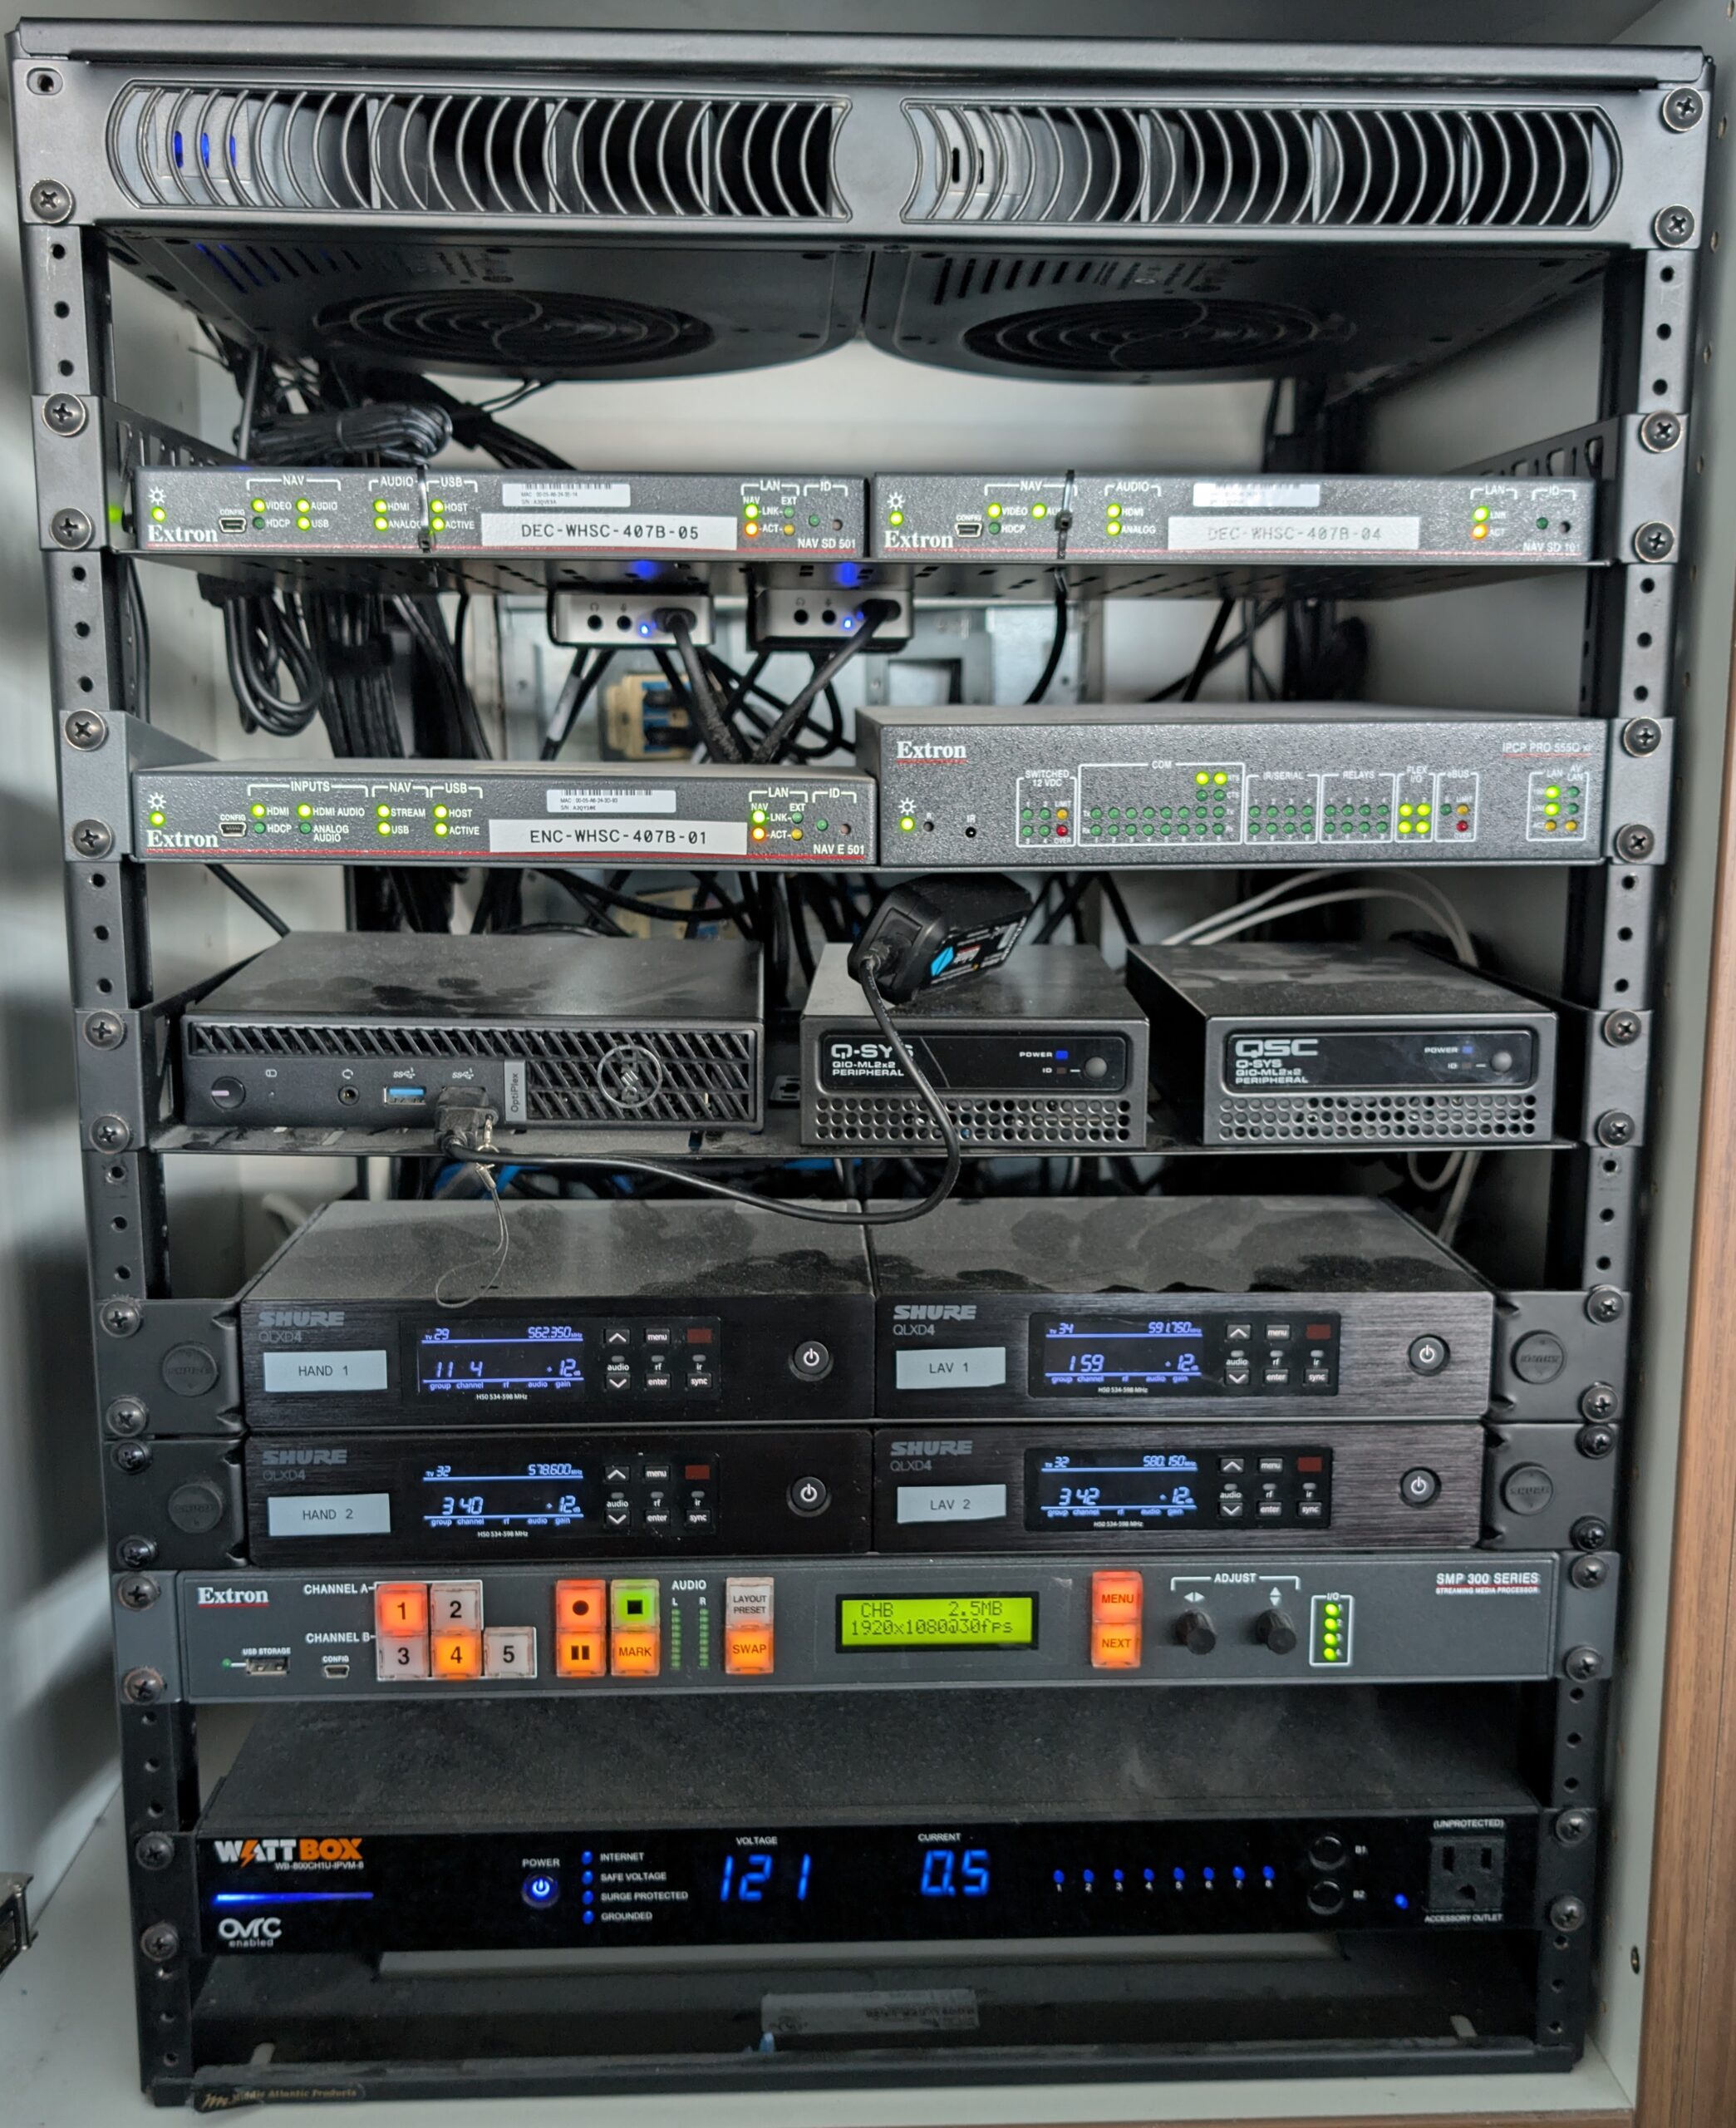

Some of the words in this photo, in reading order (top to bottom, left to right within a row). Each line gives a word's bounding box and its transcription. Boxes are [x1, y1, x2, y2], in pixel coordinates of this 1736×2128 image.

[283, 476, 304, 486] NAV
[380, 477, 414, 488] AUDIO
[440, 477, 463, 488] USB
[760, 480, 780, 490] LAN
[820, 481, 832, 491] ID
[1019, 482, 1042, 491] NAV
[1116, 482, 1149, 492] AUDIO
[1486, 485, 1505, 495] LAN
[267, 501, 292, 511] VIDEO
[782, 497, 798, 505] EXT
[312, 502, 337, 512] AUDIO
[387, 502, 410, 512] HDMI
[444, 503, 468, 513] HOST
[267, 519, 290, 530] HDCP
[312, 520, 328, 530] USB
[445, 520, 476, 530] ACTIVE
[149, 525, 219, 544] Extron
[521, 525, 699, 539] DEC-WHSC-407B-05
[799, 539, 818, 549] NAV
[821, 539, 835, 549] SD
[839, 539, 855, 549] 501
[885, 530, 953, 549] Extron
[1547, 543, 1561, 553] SD
[897, 741, 967, 758] Extron
[1502, 742, 1527, 753] IPCP
[1530, 742, 1552, 753] PRO
[1152, 761, 1173, 770] COM
[1407, 766, 1427, 774] FLEX
[1025, 770, 1070, 778] SWITCHED
[1263, 771, 1304, 780] IR/SERIAL
[1343, 771, 1375, 779] RELAYS
[1447, 769, 1469, 778] eBUS
[291, 781, 330, 791] INPUTS
[390, 782, 411, 793] NAV
[445, 783, 467, 794] USB
[1044, 779, 1062, 787] VDC
[769, 787, 789, 798] LAN
[829, 788, 840, 798] ID
[267, 808, 289, 818] HDMI
[789, 803, 806, 812] EXT
[219, 814, 246, 822] CONFIG
[337, 809, 365, 820] AUDIO
[391, 809, 425, 819] STREAM
[449, 810, 473, 820] HOST
[267, 825, 292, 836] HDCP
[313, 825, 349, 835] ANALOG
[391, 826, 409, 835] USB
[450, 826, 479, 836] ACTIVE
[147, 830, 219, 848] Extron
[530, 830, 706, 845] ENC-WHSC-407B-01
[814, 845, 834, 855] NAV
[838, 845, 845, 855] E
[848, 845, 864, 855] 501
[1236, 1039, 1318, 1057] QSC
[1236, 1059, 1282, 1069] Q-SYS
[511, 1072, 522, 1113] OptiPlex
[893, 1305, 976, 1322] SHURE
[259, 1311, 345, 1328] SHURE
[435, 1328, 450, 1340] 29
[893, 1324, 935, 1336] QLXD4
[1059, 1323, 1075, 1334] 34
[259, 1332, 302, 1343] QLXD4
[299, 1366, 333, 1377] HAND
[343, 1366, 349, 1377] 1
[929, 1362, 954, 1373] LAV
[963, 1362, 969, 1372] 1
[691, 1378, 709, 1387] sync
[1309, 1374, 1325, 1382] sync
[430, 1383, 451, 1392] group
[456, 1381, 484, 1389] channel
[556, 1381, 571, 1390] gain
[891, 1441, 973, 1456] SHURE
[263, 1449, 347, 1465] SHURE
[1055, 1456, 1070, 1468] 32
[436, 1465, 451, 1477] 32
[891, 1460, 932, 1471] QLXD4
[263, 1470, 306, 1481] QLXD4
[931, 1500, 955, 1510] LAV
[962, 1499, 971, 1509] 2
[302, 1510, 337, 1520] HAND
[346, 1509, 353, 1520] 2
[1301, 1506, 1319, 1515] sync
[430, 1518, 452, 1527] group
[457, 1517, 484, 1525] channel
[555, 1517, 571, 1526] gain
[647, 1514, 668, 1522] enter
[690, 1514, 708, 1523] sync
[1214, 1573, 1257, 1583] ADJUST
[1436, 1573, 1464, 1585] SMP
[1468, 1573, 1491, 1584] 300
[1493, 1572, 1541, 1584] SERIES
[304, 1584, 358, 1595] CHANNEL
[361, 1584, 369, 1594] A
[671, 1579, 707, 1590] AUDIO
[198, 1587, 268, 1604] Extron
[1436, 1587, 1473, 1595] STREAMING
[1497, 1586, 1540, 1594] PROCESSOR
[733, 1595, 767, 1604] LAYOUT
[1101, 1594, 1134, 1605] MENU
[397, 1602, 406, 1620] 1
[450, 1600, 462, 1618] 2
[733, 1606, 766, 1615] PRESET
[861, 1603, 894, 1618] CHB
[948, 1601, 1003, 1617] 2.5MB
[306, 1633, 360, 1644] CHANNEL
[363, 1633, 371, 1643] B
[1102, 1638, 1132, 1648] NEXT
[258, 1648, 291, 1656] STORAGE
[502, 1645, 515, 1663] 5
[618, 1647, 652, 1657] MARK
[732, 1643, 766, 1654] SWAP
[322, 1655, 349, 1663] CONFIG
[397, 1647, 410, 1665] 3
[450, 1646, 463, 1664] 4
[1434, 1819, 1505, 1830] (UNPROTECTED)
[735, 1835, 778, 1846] VOLTAGE
[917, 1832, 962, 1843] CURRENT
[522, 1858, 560, 1869] POWER
[600, 1853, 645, 1863] INTERNET
[601, 1874, 625, 1883] SAFE
[627, 1872, 666, 1882] VOLTAGE
[720, 1853, 811, 1903] 121
[921, 1849, 991, 1897] 0.5
[601, 1893, 632, 1903] SURGE
[634, 1891, 689, 1902] PROTECTED
[601, 1912, 652, 1922] GROUNDED
[1424, 1914, 1471, 1924] ACCESSORY
[1472, 1914, 1503, 1923] OUTLET
[229, 1938, 274, 1948] enabled
